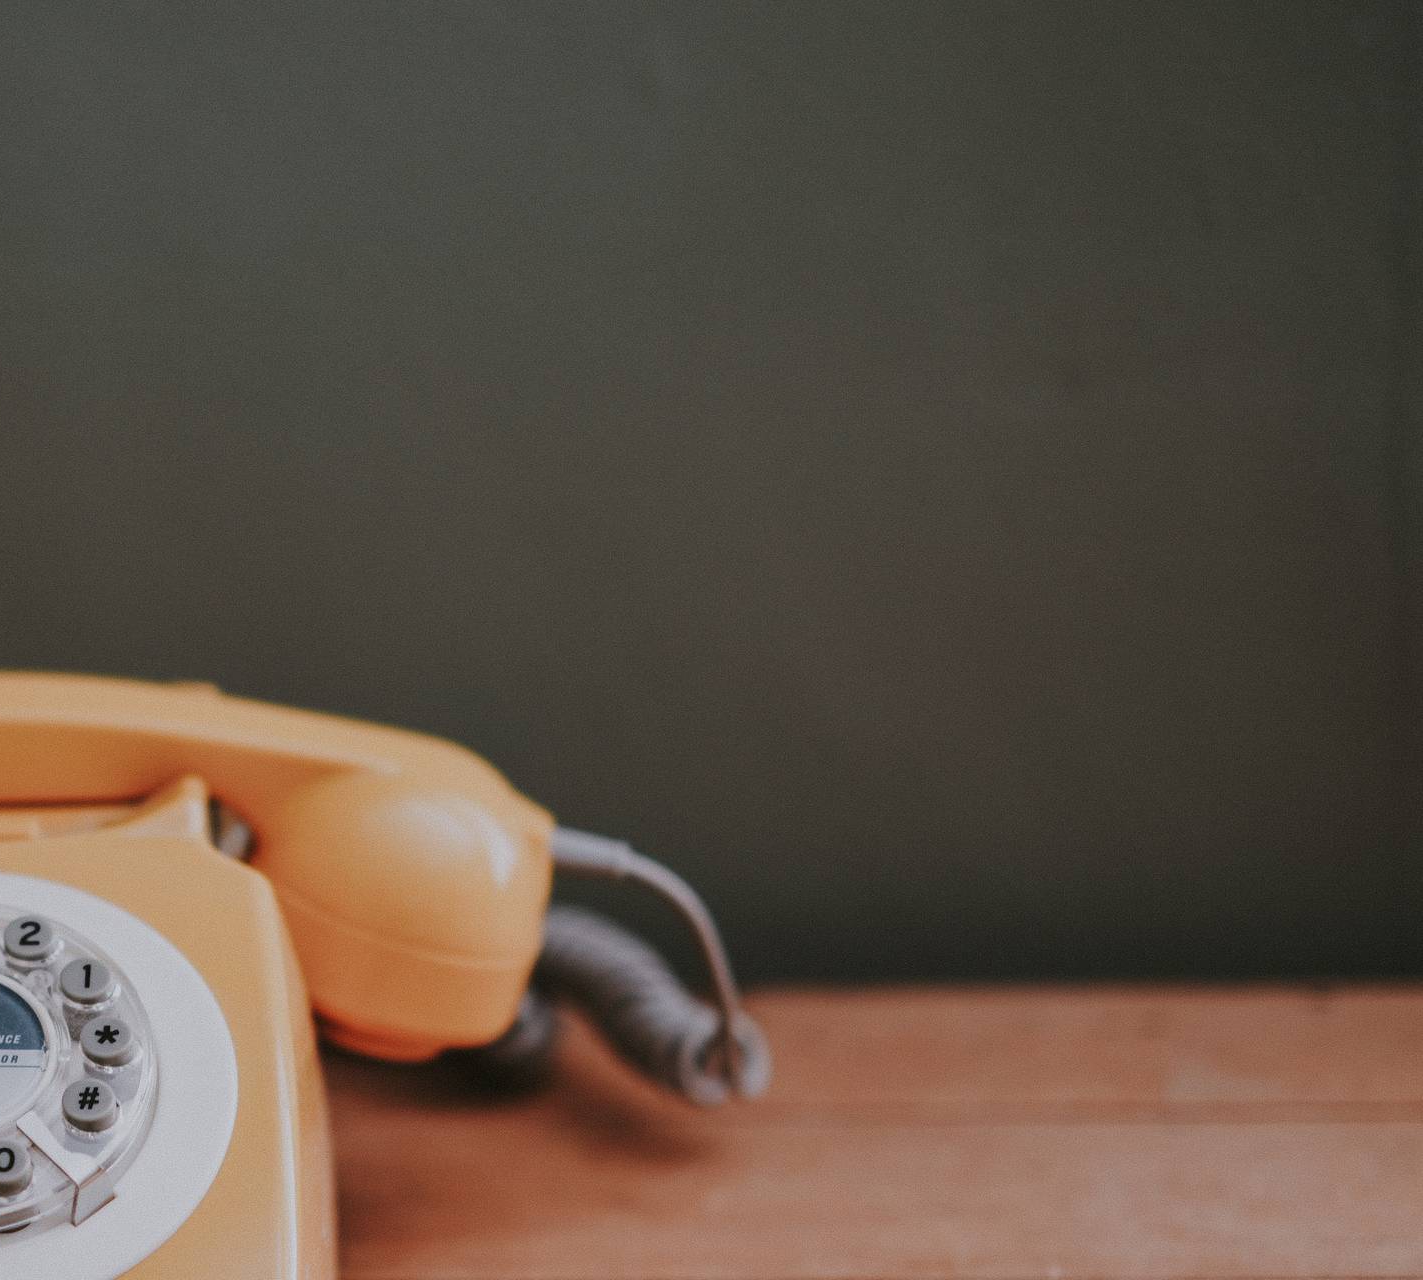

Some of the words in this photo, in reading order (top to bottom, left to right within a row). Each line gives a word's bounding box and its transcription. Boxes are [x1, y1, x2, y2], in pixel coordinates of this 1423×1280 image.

[19, 921, 41, 946] 2
[82, 964, 92, 988] 1
[78, 1087, 100, 1110] #
